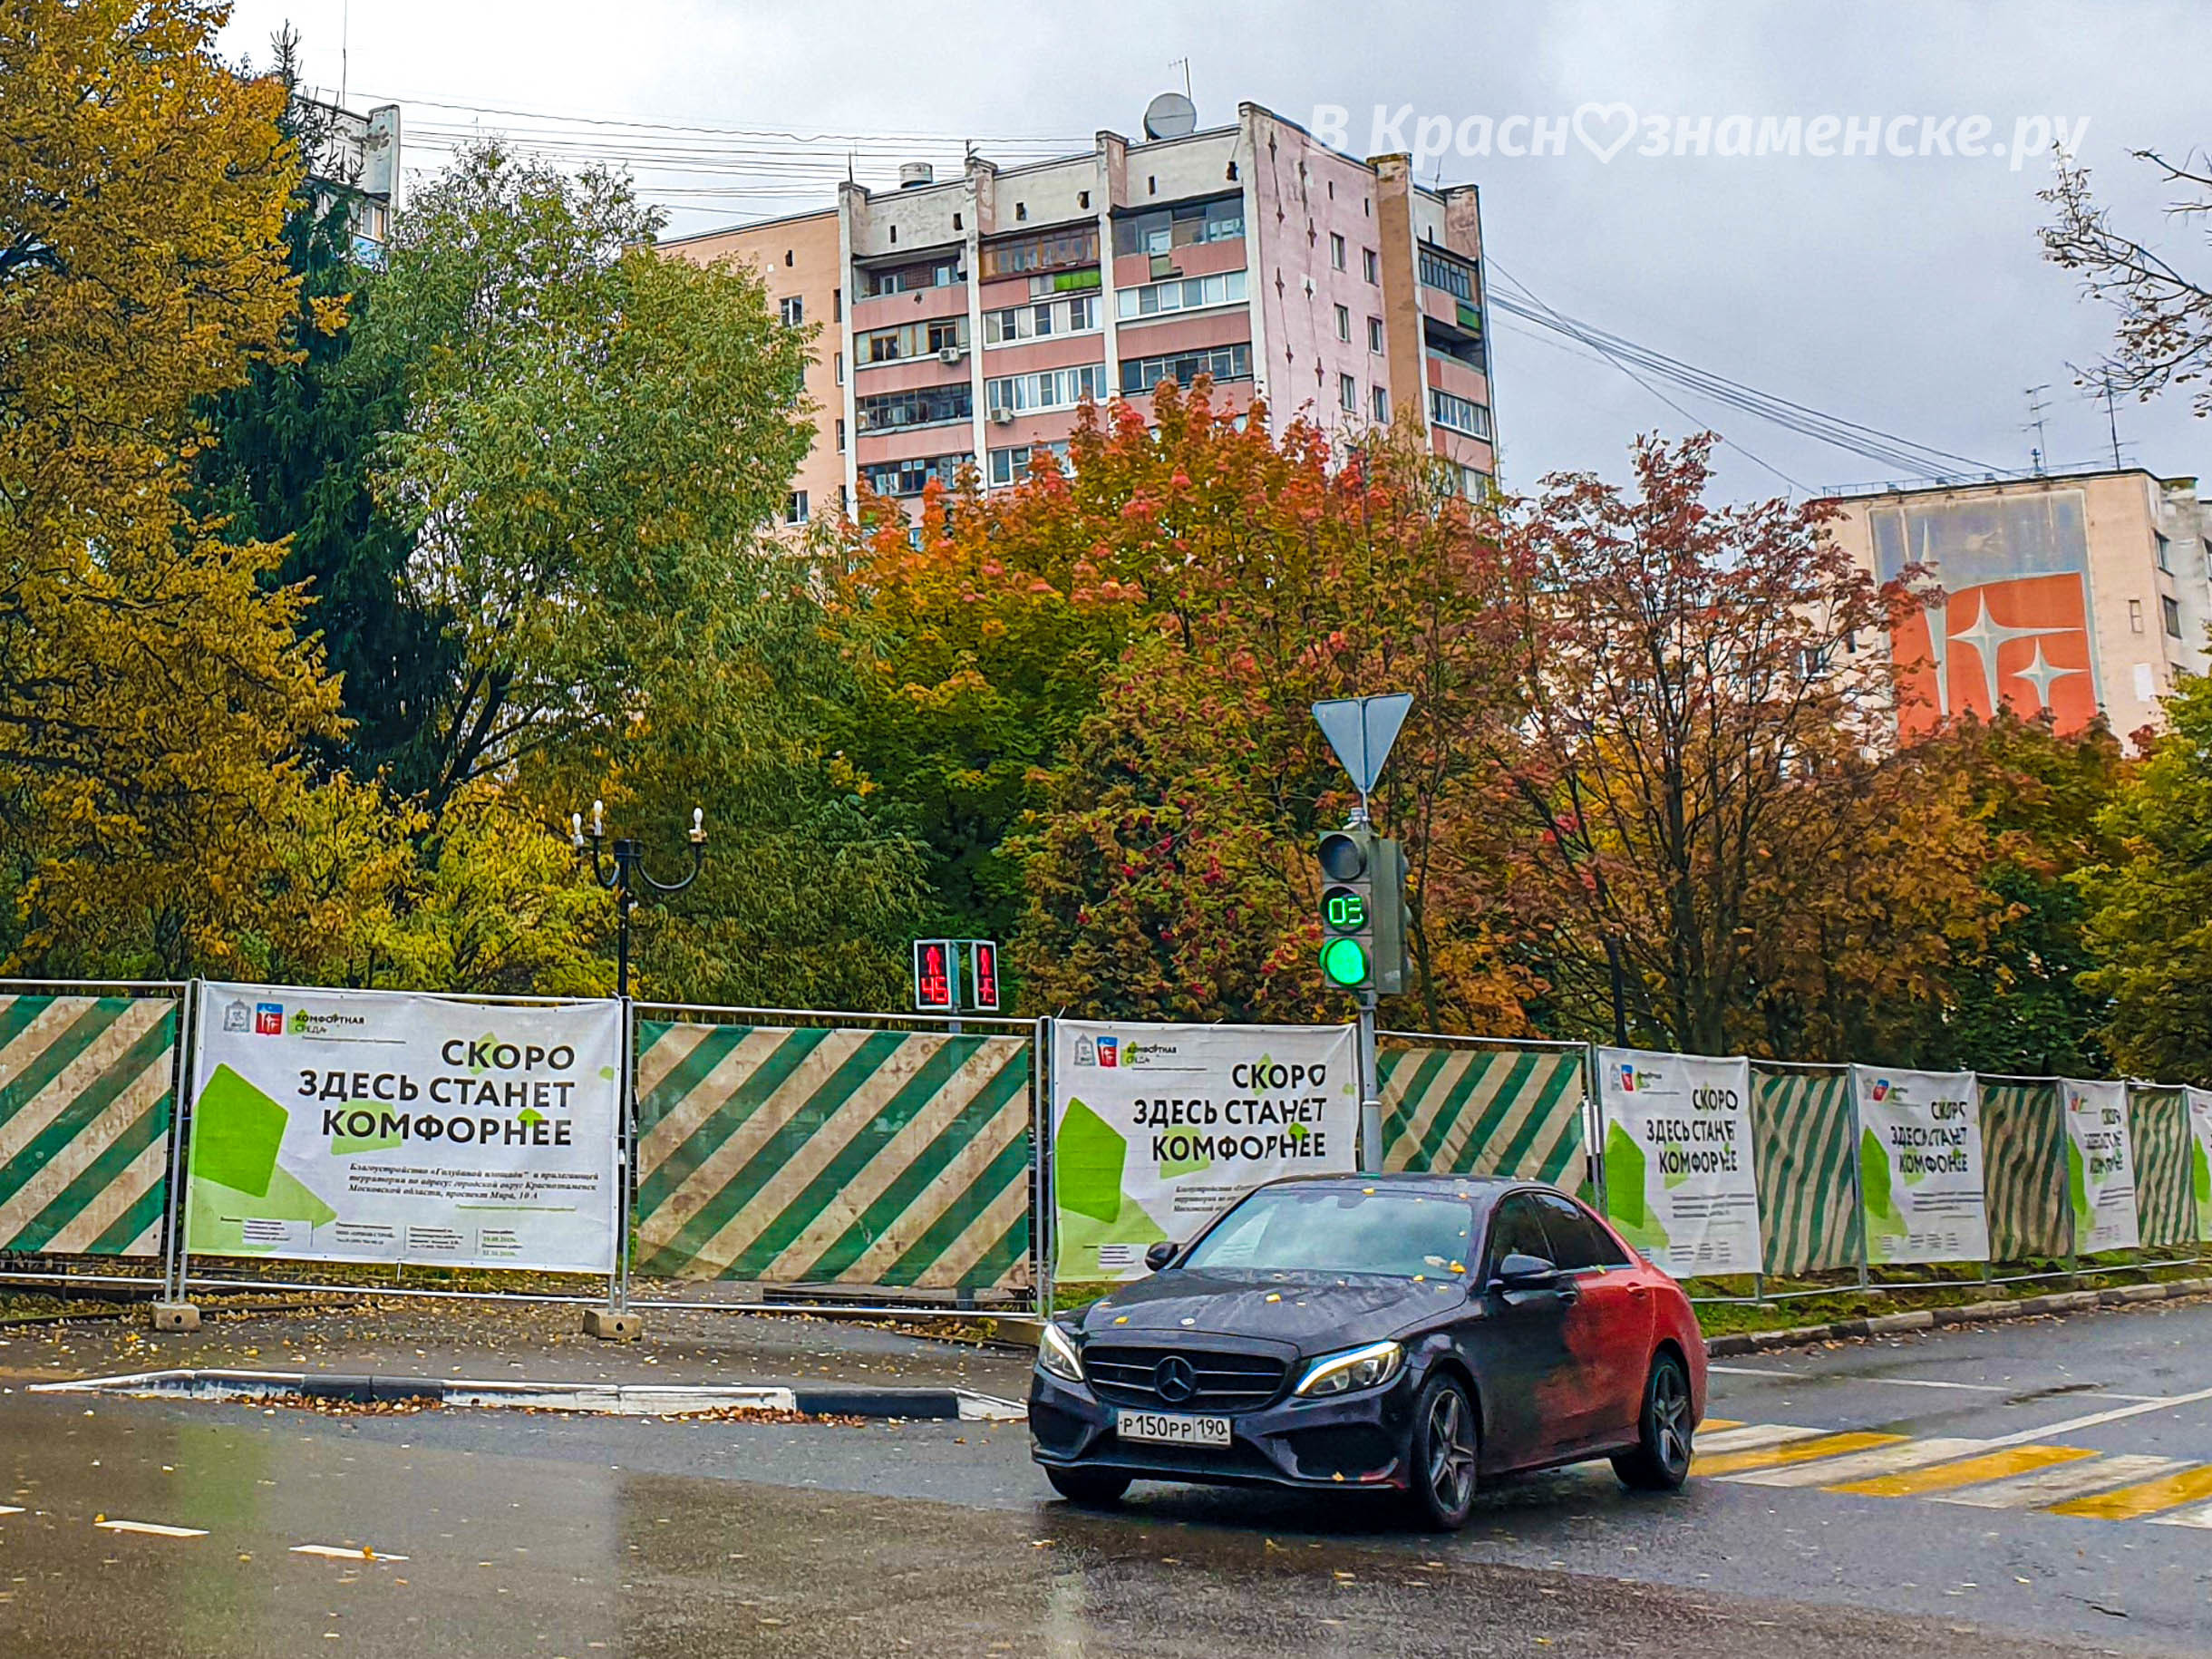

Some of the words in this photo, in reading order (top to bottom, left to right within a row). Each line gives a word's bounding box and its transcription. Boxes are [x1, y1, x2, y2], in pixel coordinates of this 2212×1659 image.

[921, 976, 948, 1003] 45
[441, 1039, 575, 1071] СКОРО
[298, 1070, 419, 1101] ЗДЕСЬ
[430, 1076, 575, 1108] СТАНЕТ
[1232, 1064, 1326, 1089] СКОРО
[1132, 1099, 1218, 1130] ЗДЕСЬ
[1225, 1098, 1327, 1125] СТАНЕТ
[1693, 1089, 1738, 1111] СКОРО
[323, 1110, 572, 1147] КОМФОРНЕЕ
[1646, 1119, 1690, 1145] ЗДЕСЬ
[1152, 1132, 1326, 1161] КОМФОРНЕЕ
